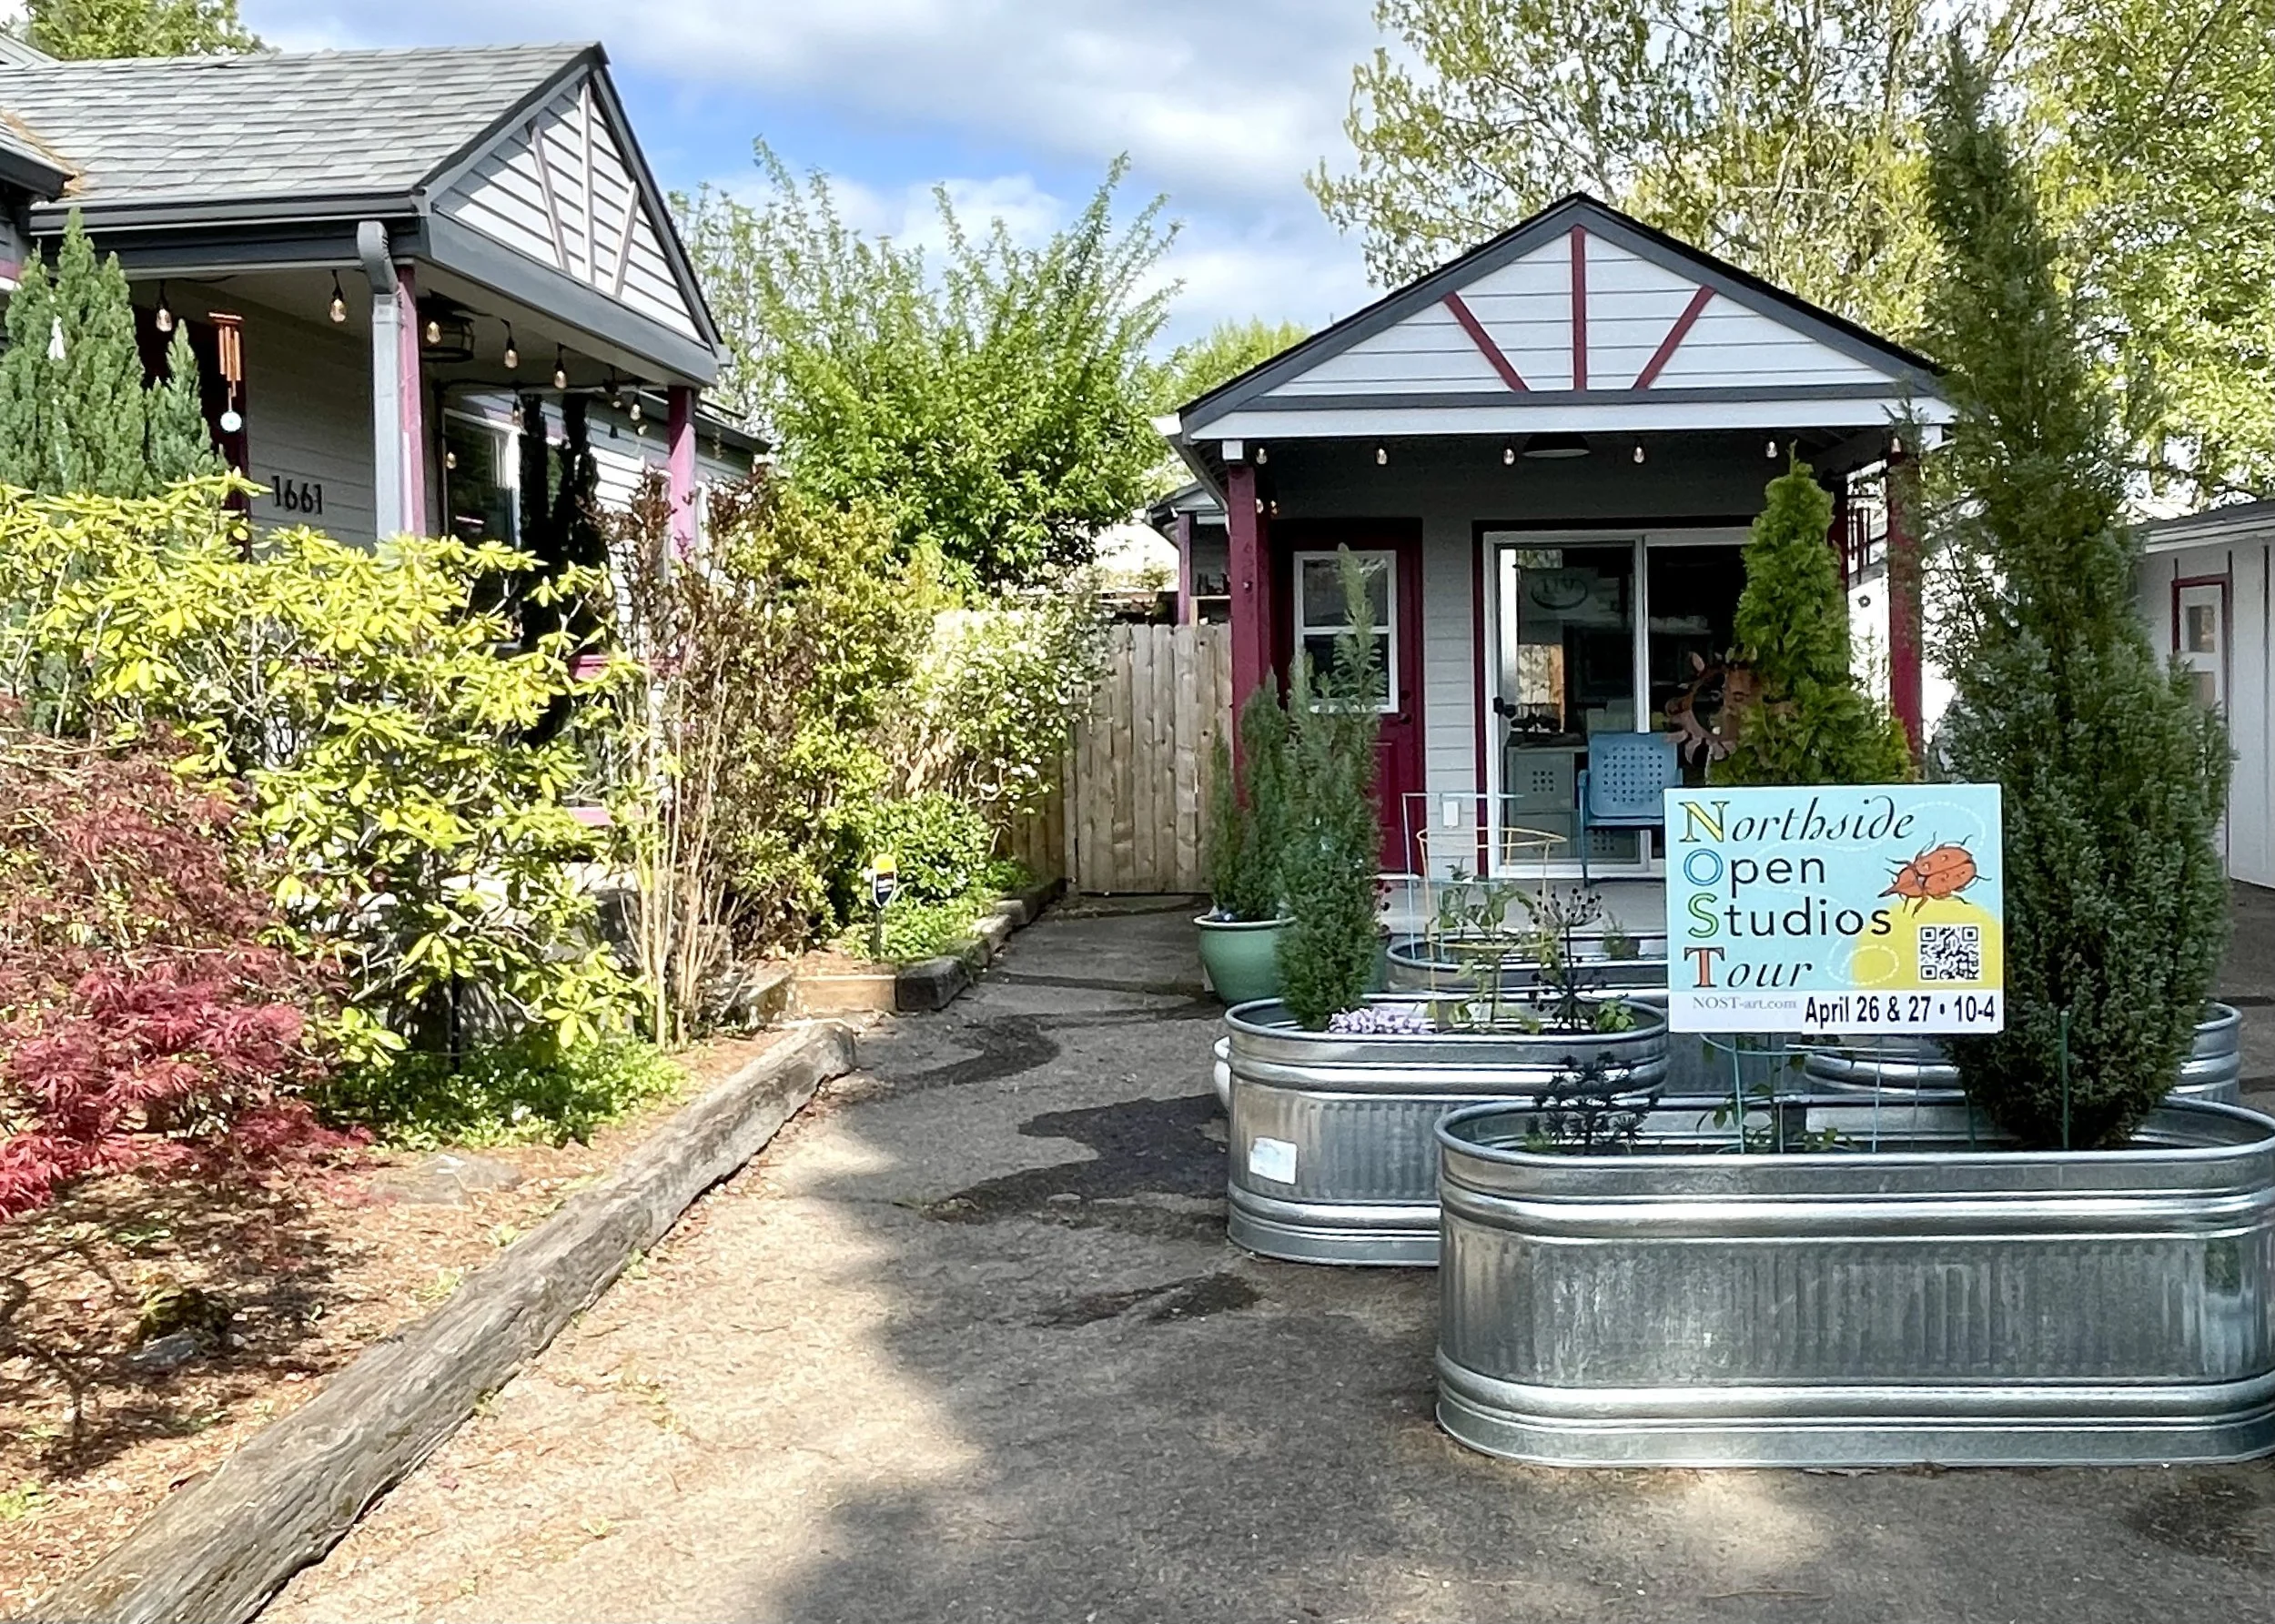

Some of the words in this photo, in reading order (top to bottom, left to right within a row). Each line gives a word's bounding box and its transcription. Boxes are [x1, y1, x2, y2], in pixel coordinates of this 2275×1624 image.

[271, 475, 322, 515] 1661
[1678, 795, 1915, 843] Northside
[1684, 848, 1825, 899] Open
[1688, 893, 1892, 939] Studios
[1684, 946, 1813, 989] Tour
[1693, 996, 1797, 1010] NOST-art.com
[1805, 995, 1849, 1029] April
[1856, 995, 1880, 1023] 26
[1887, 995, 1900, 1022] &
[1908, 995, 1931, 1022] 27
[1954, 995, 1995, 1023] 10-4
